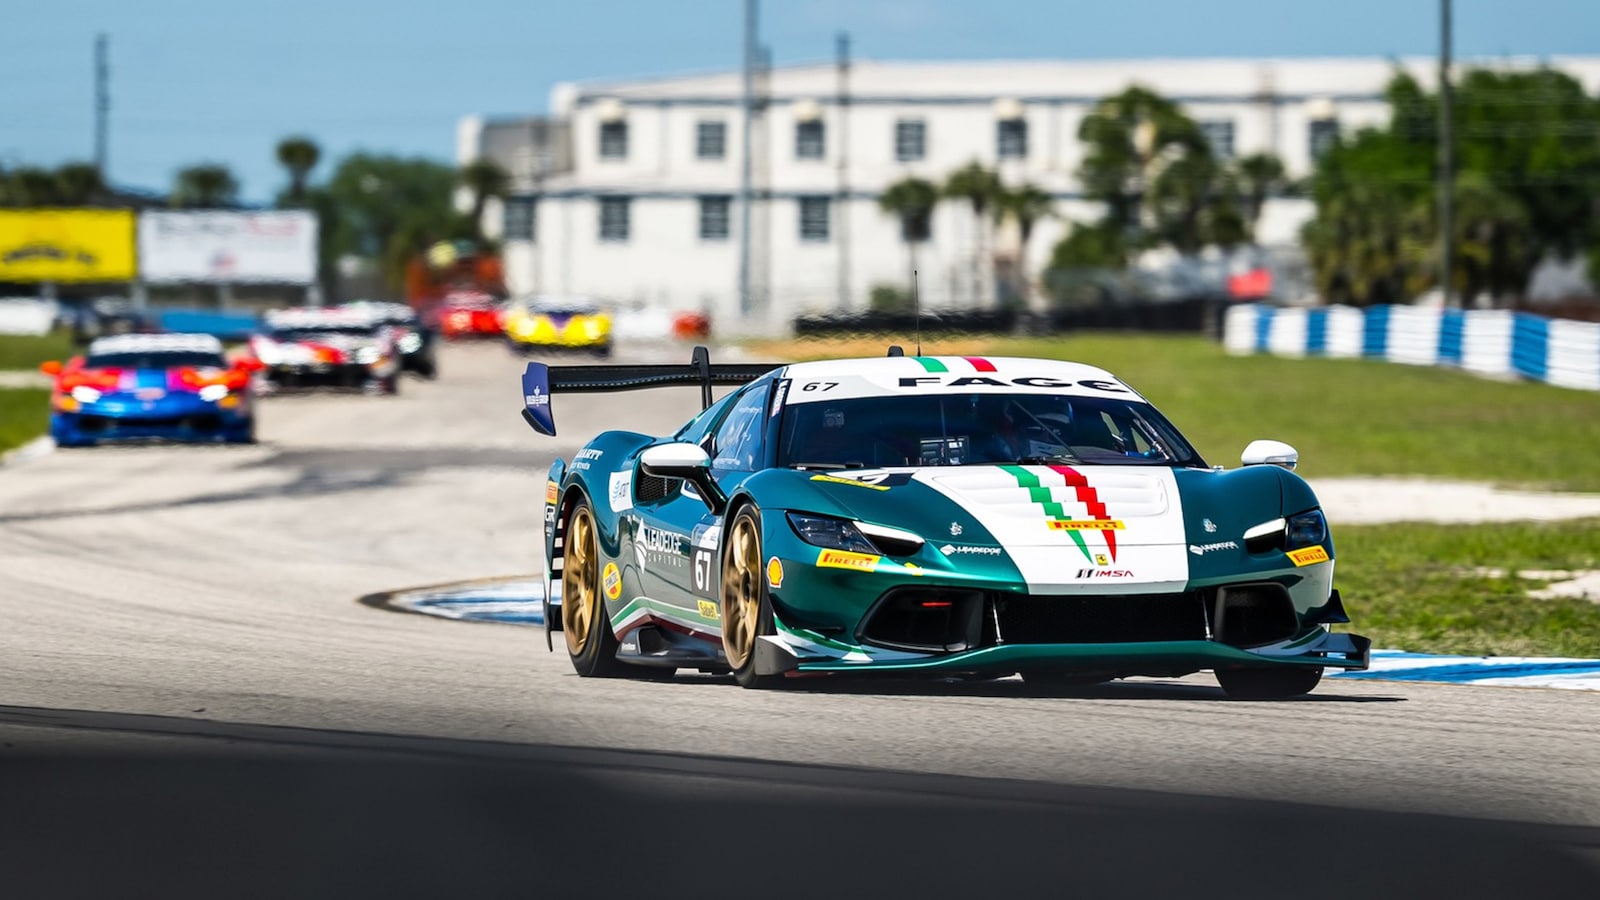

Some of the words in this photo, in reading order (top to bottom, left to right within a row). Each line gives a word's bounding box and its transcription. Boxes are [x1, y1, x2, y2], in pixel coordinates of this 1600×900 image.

[802, 381, 839, 392] 67
[898, 377, 1131, 393] FAGE
[1053, 521, 1119, 529] PIRELLI
[648, 527, 682, 555] LEADEDGE
[648, 553, 682, 568] CAPITAL
[823, 552, 873, 567] PIRELLI
[695, 550, 711, 592] 67
[1095, 569, 1134, 578] IMSA
